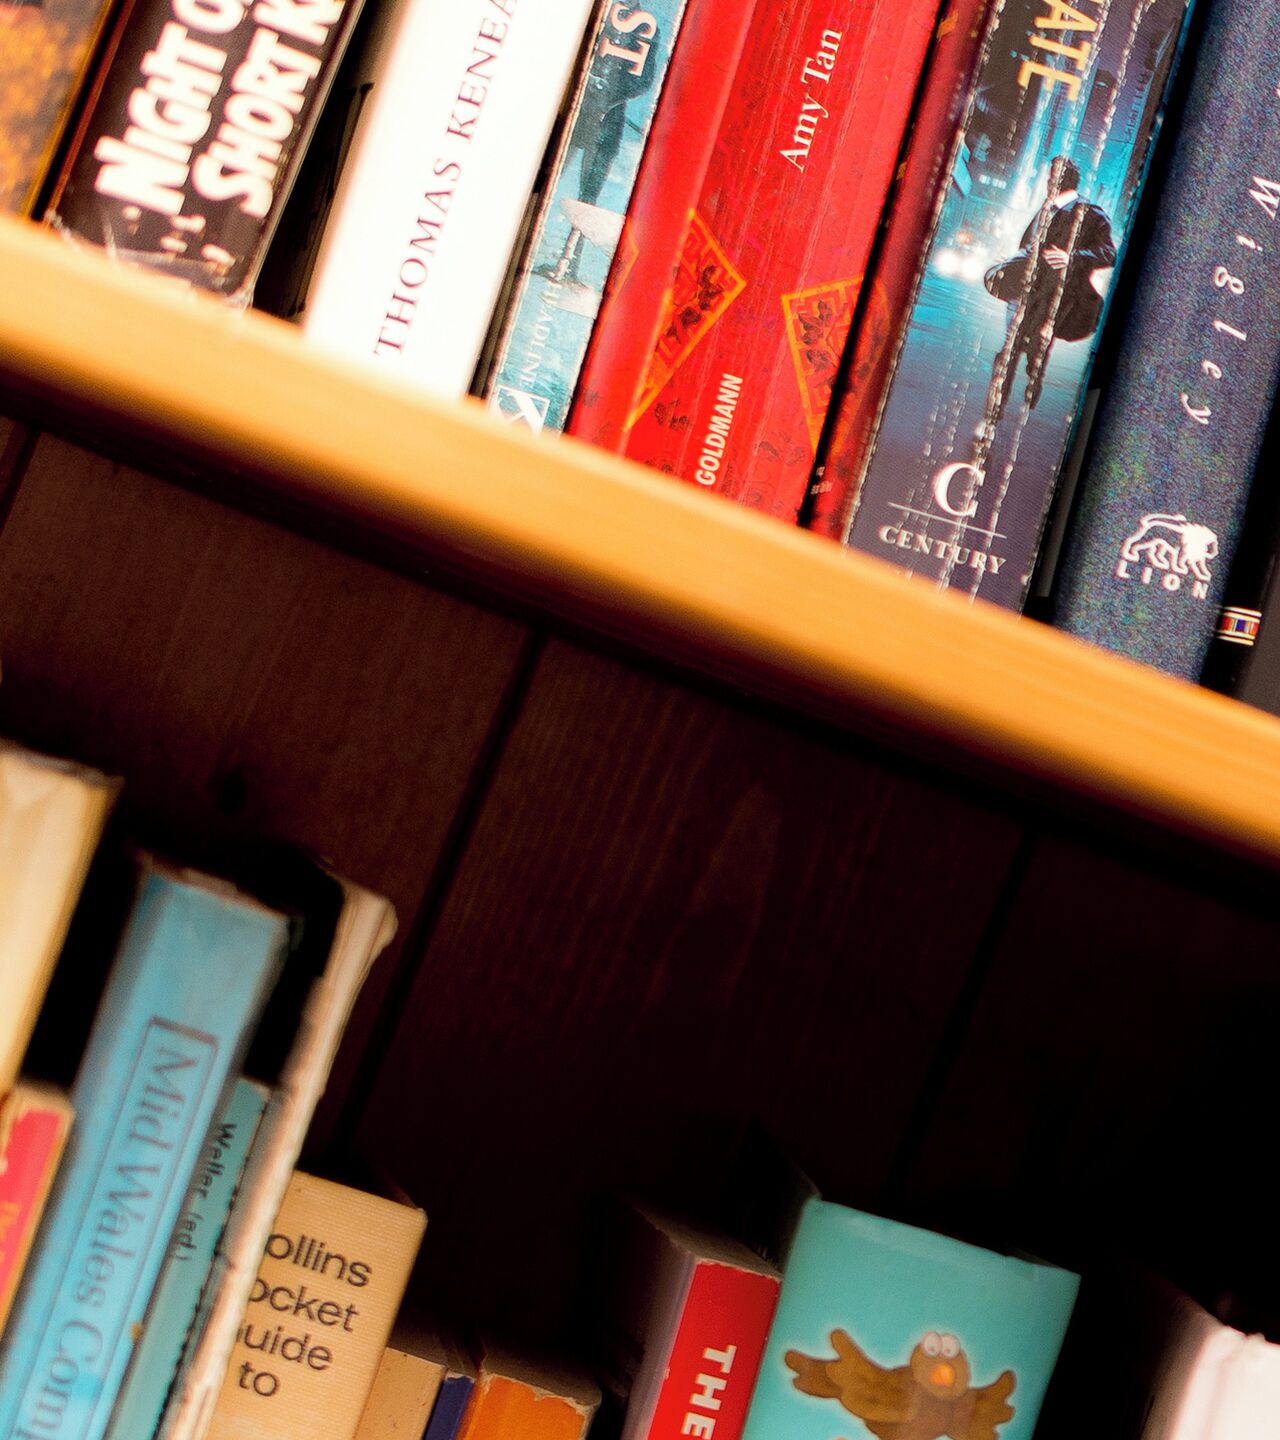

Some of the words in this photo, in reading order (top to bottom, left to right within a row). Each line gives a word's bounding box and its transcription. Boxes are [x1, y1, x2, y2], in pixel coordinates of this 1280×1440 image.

[800, 28, 842, 86] Tan
[93, 20, 228, 216] NIGHT
[191, 27, 322, 219] SHORT
[778, 94, 829, 173] Amy
[373, 156, 462, 357] THOMAS
[695, 373, 743, 487] GOLDMANN
[878, 525, 1007, 575] CENTURY
[1116, 560, 1209, 600] LION
[128, 1044, 198, 1155] Mid
[199, 1122, 238, 1202] Waller
[72, 1160, 163, 1310] Wales
[240, 1361, 281, 1399] to
[680, 1344, 737, 1440] THE
